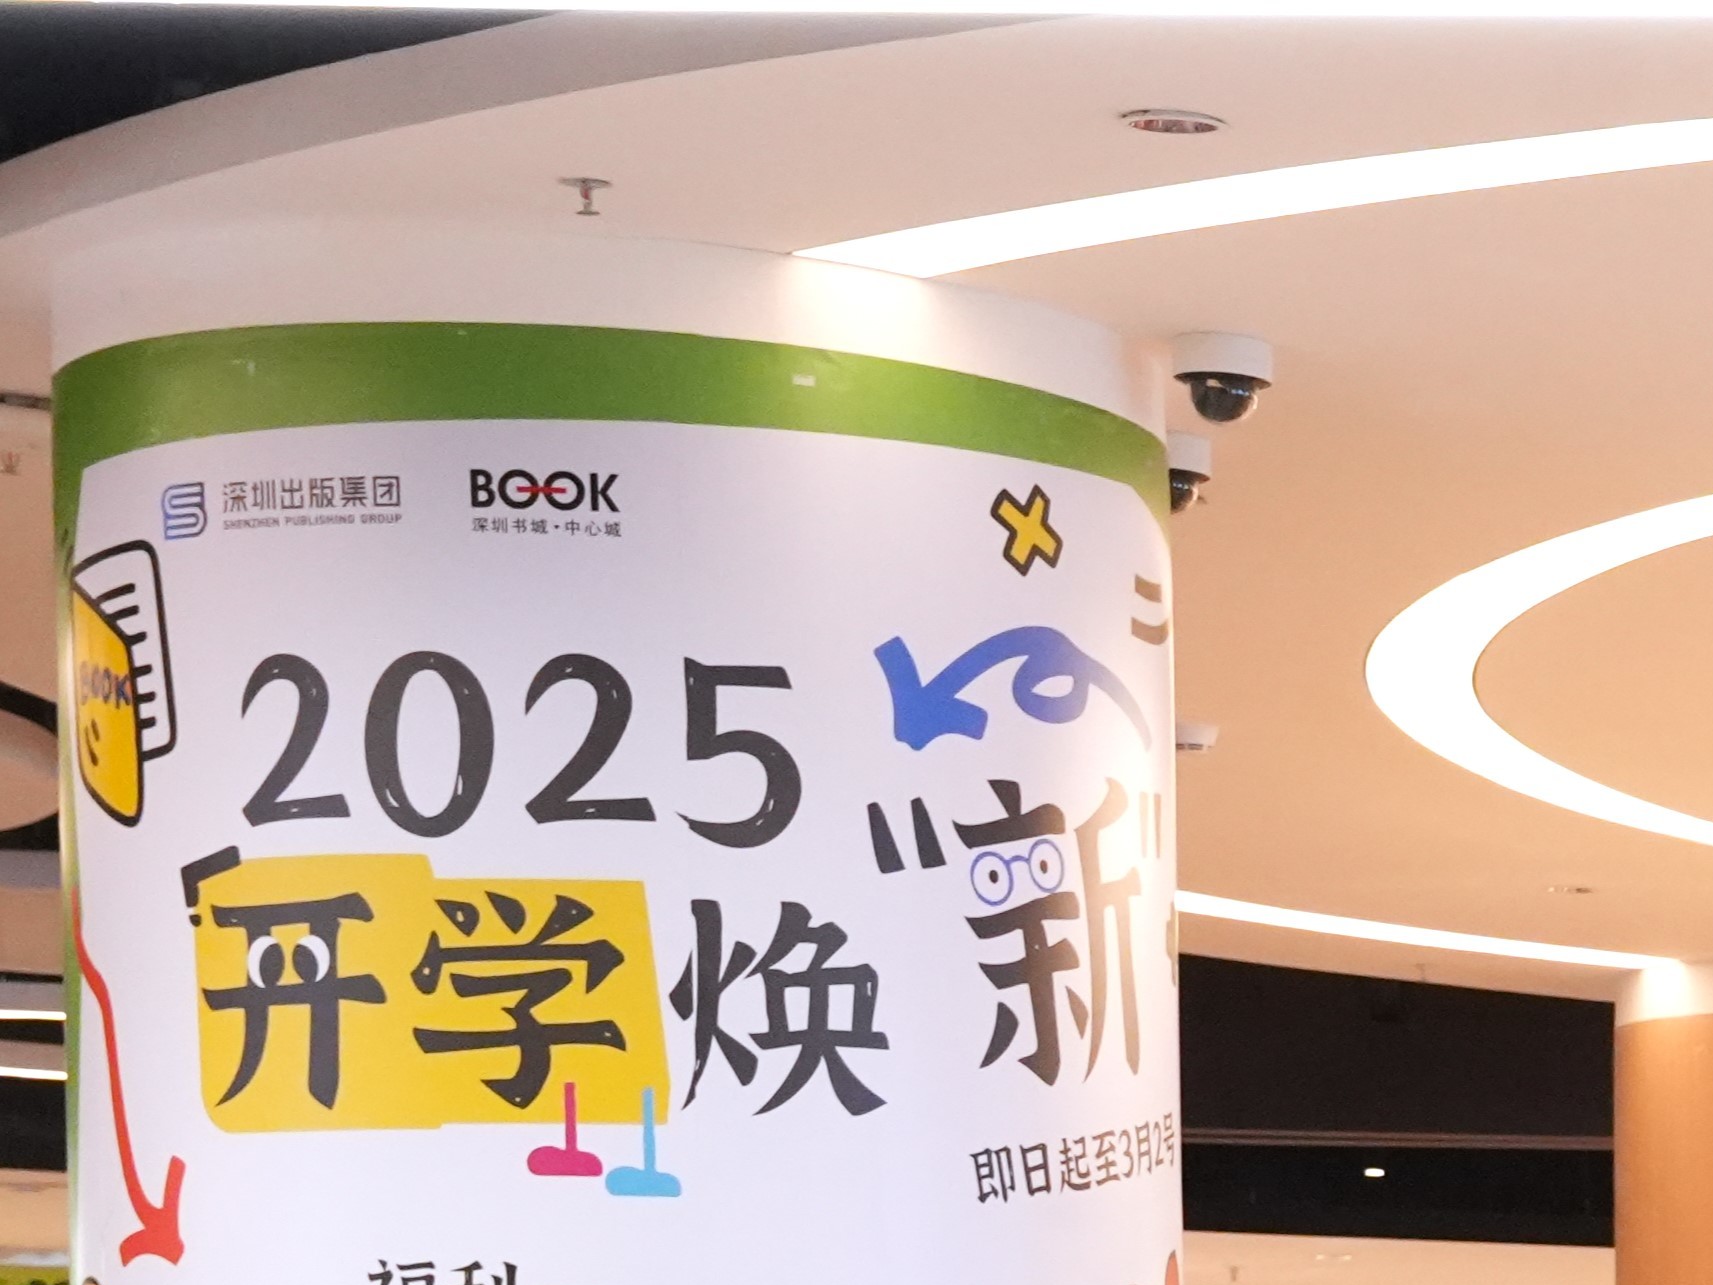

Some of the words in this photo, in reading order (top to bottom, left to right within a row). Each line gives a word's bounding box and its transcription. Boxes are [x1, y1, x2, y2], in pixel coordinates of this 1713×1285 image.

[223, 475, 401, 514] 深圳出版集团
[471, 468, 620, 513] BOOK
[223, 518, 280, 530] SHENZHEN
[284, 515, 355, 527] PUBLISHING
[362, 513, 402, 525] GROUP
[472, 517, 621, 537] 深圳书城·中心城
[241, 651, 802, 847] 2025
